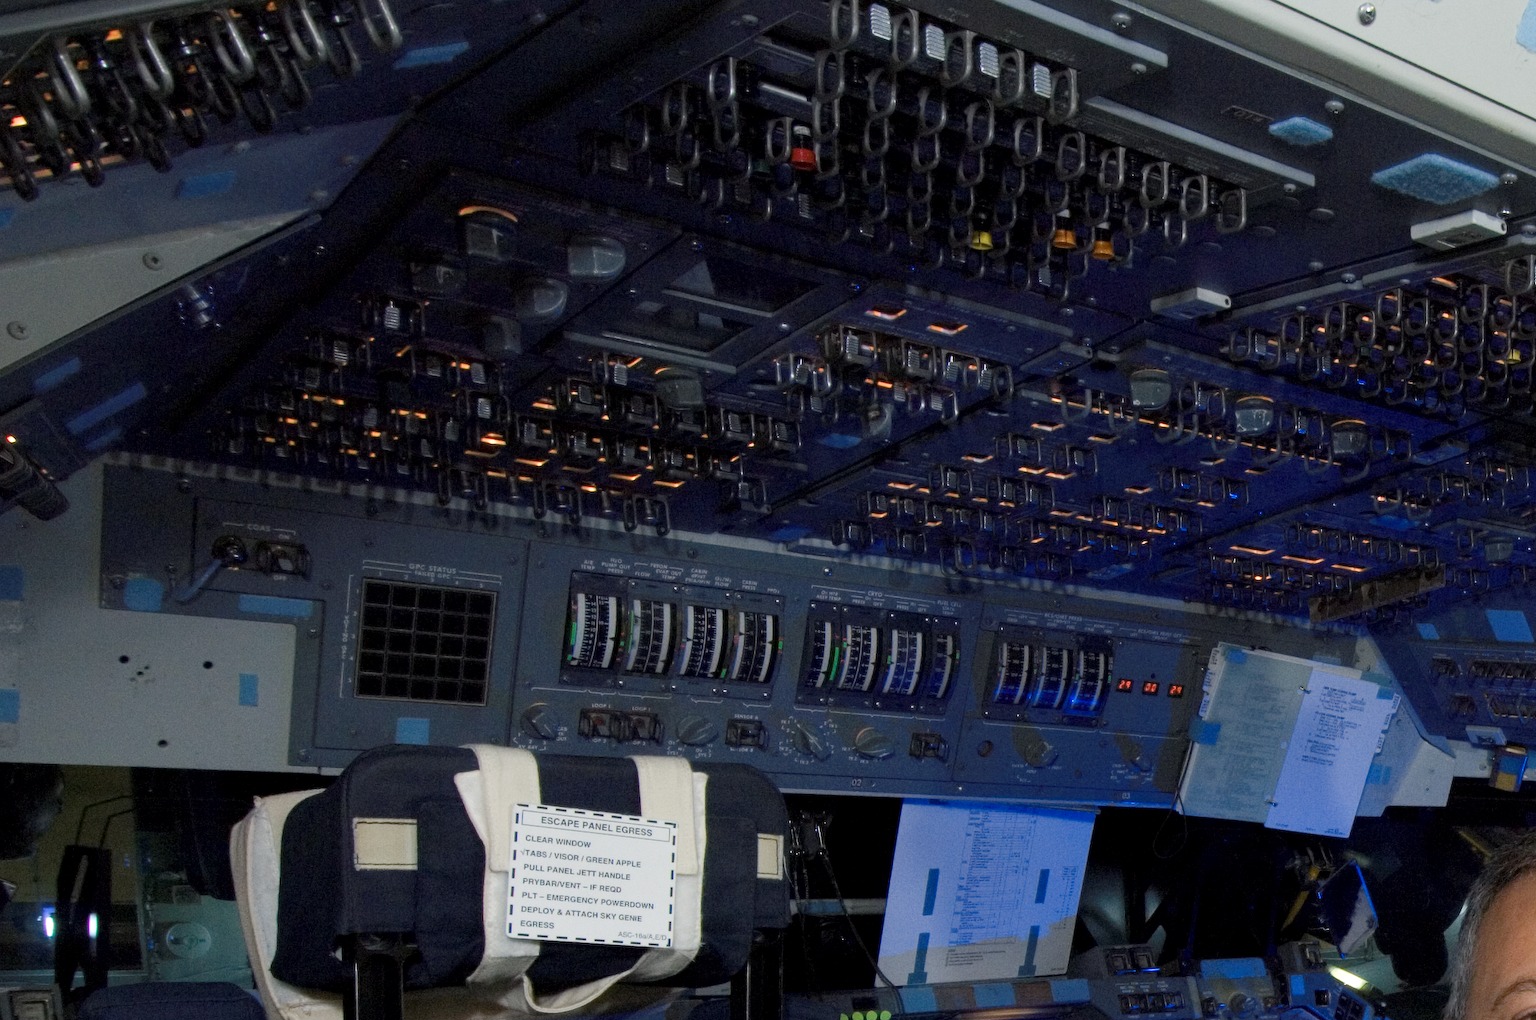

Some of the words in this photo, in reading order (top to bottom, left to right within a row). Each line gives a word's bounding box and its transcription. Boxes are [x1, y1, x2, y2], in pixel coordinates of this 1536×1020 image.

[428, 565, 456, 574] STATUS
[1119, 680, 1131, 689] 29
[1170, 685, 1182, 695] 29
[541, 816, 579, 827] ESCAPE
[582, 821, 612, 831] PANEL
[615, 825, 652, 836] EGRESS
[525, 834, 553, 843] CLEAR
[555, 838, 591, 847] WINDOW
[524, 849, 547, 858] TABS
[554, 852, 579, 861] VISOR
[585, 856, 614, 864] GREEN
[616, 859, 640, 868] APPLE
[523, 863, 544, 871] PULL
[547, 865, 574, 874] PANEL
[598, 871, 630, 880] HANDLE
[522, 877, 581, 888] PRYBAR/VENT
[599, 884, 621, 892] REQD
[546, 893, 598, 904] EMERGENCY
[600, 898, 654, 909] POWERDOWN
[520, 905, 554, 914] DEPLOY
[565, 909, 598, 918] ATTACH
[618, 913, 641, 922] GENIE
[520, 920, 554, 929] EGRESS
